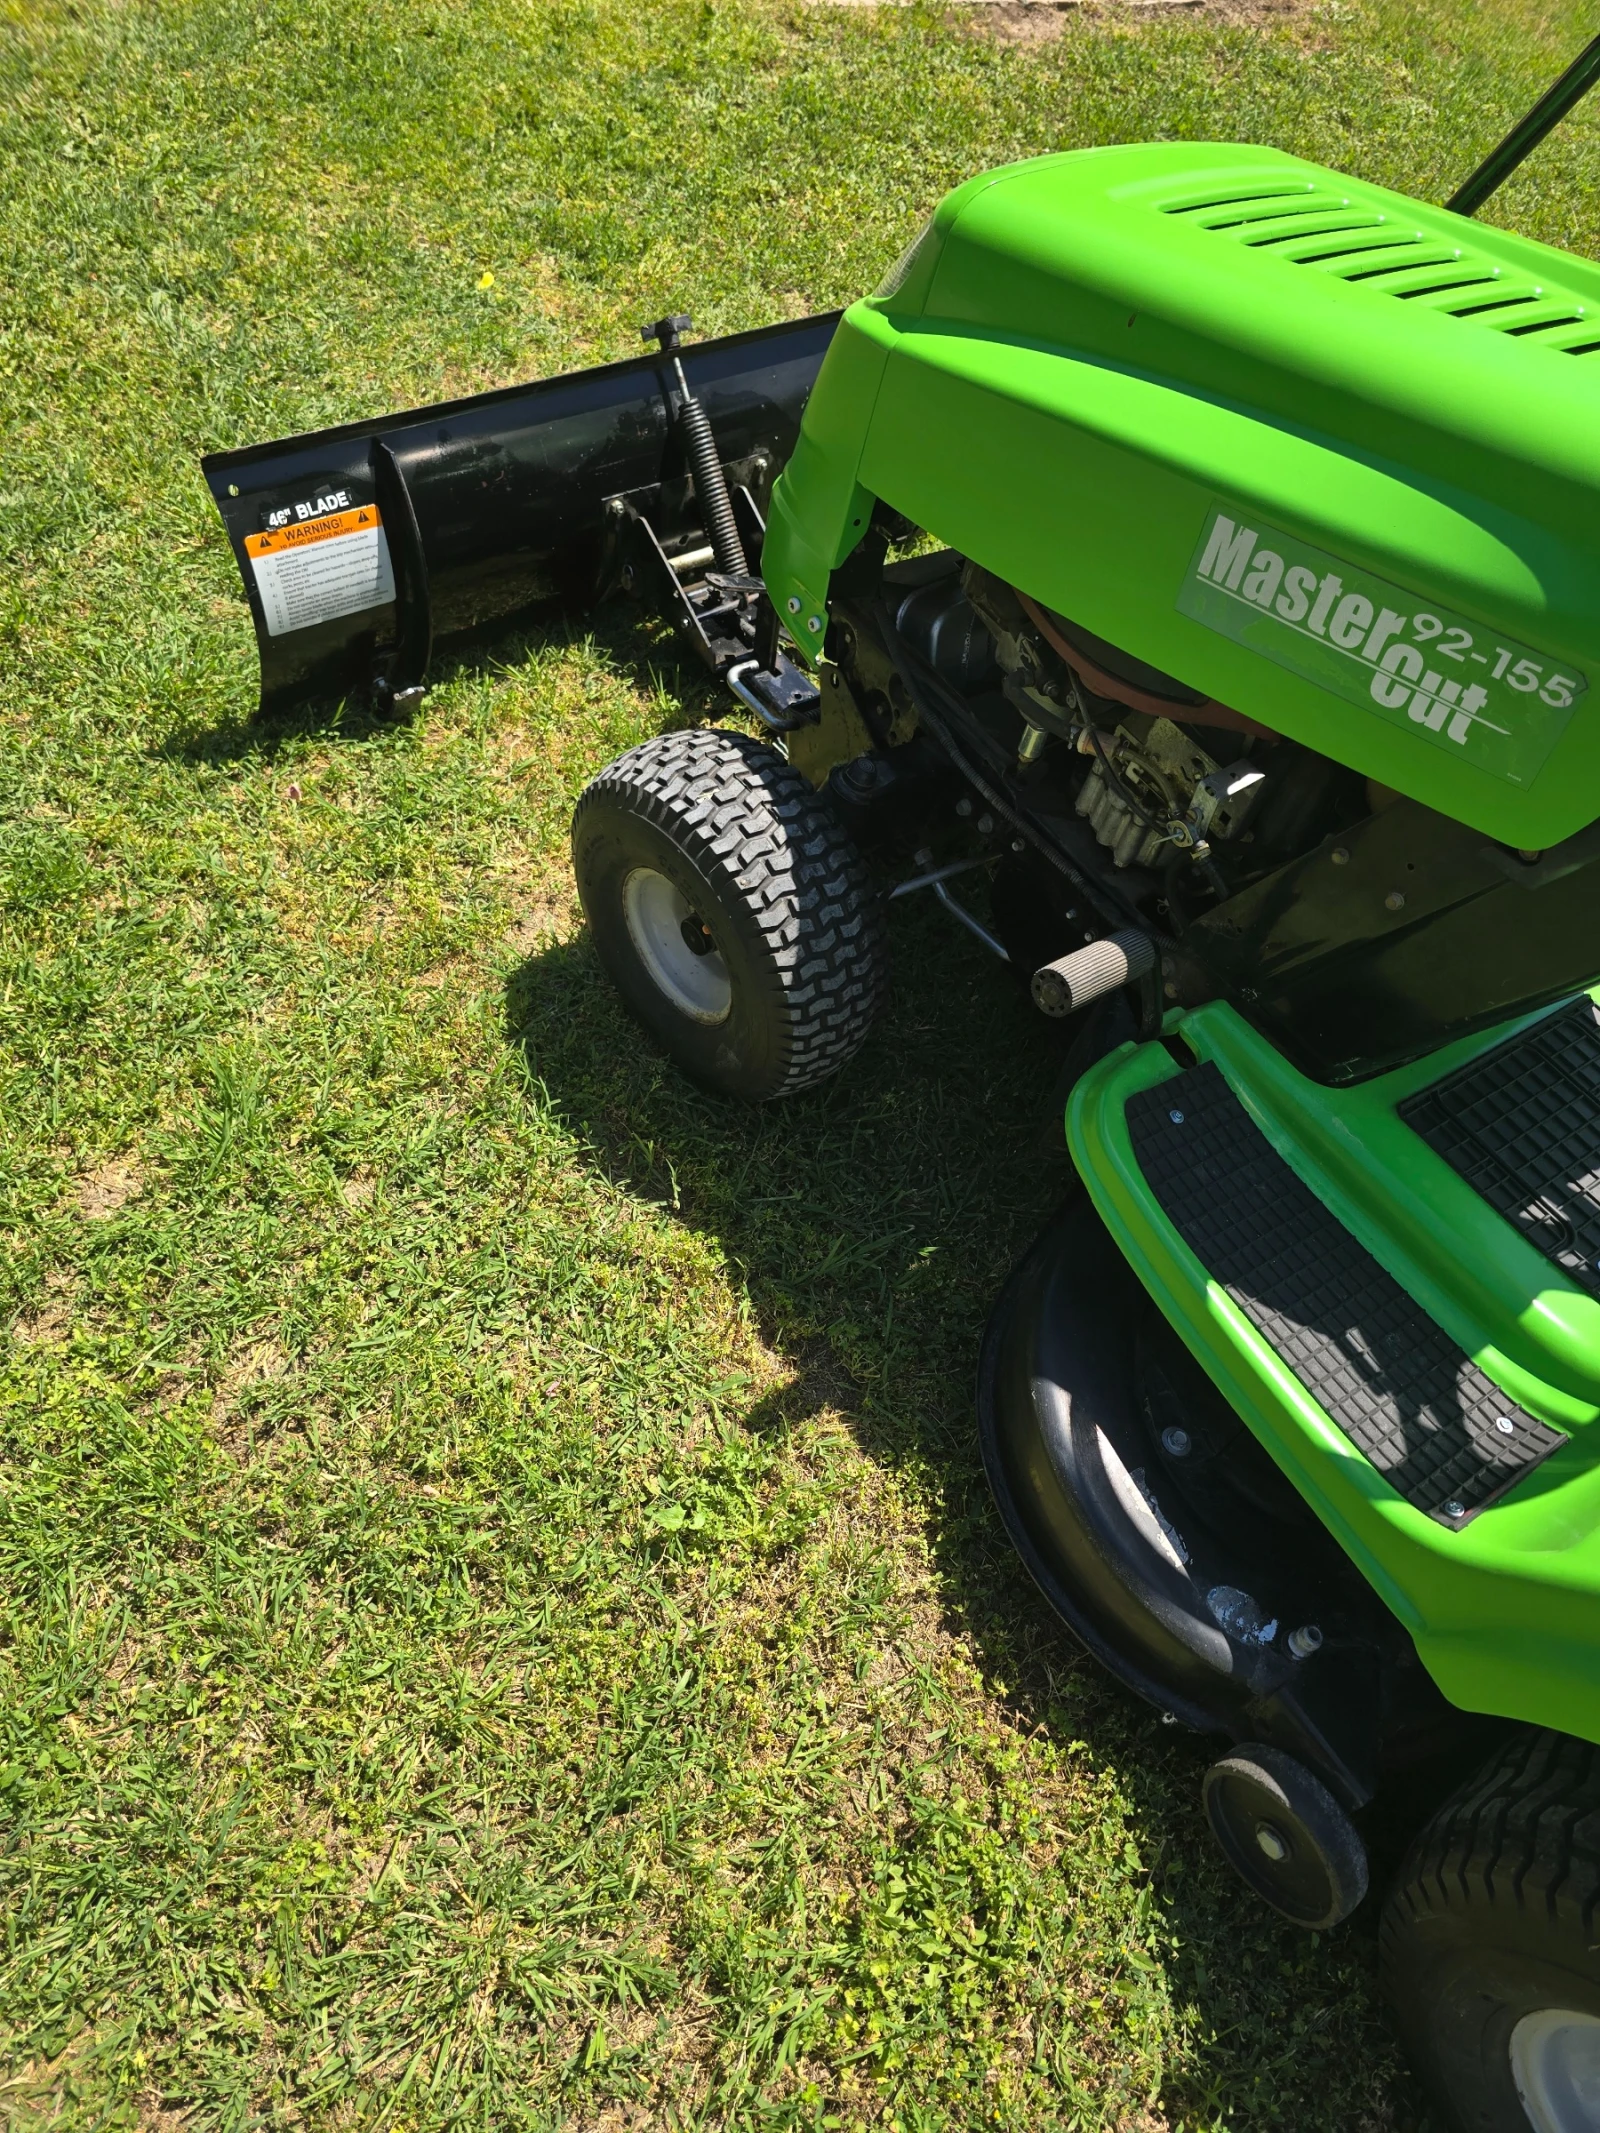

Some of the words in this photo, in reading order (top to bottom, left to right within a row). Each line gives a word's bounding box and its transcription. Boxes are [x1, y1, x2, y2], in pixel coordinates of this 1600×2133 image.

[268, 508, 291, 527] 46"
[295, 491, 350, 520] BLADE
[284, 518, 344, 541] WARNING!
[288, 539, 307, 549] AVOID
[307, 532, 333, 545] SERIOUS
[1197, 514, 1407, 661] Master
[1369, 642, 1489, 746] Cut
[1412, 613, 1578, 709] 92-155
